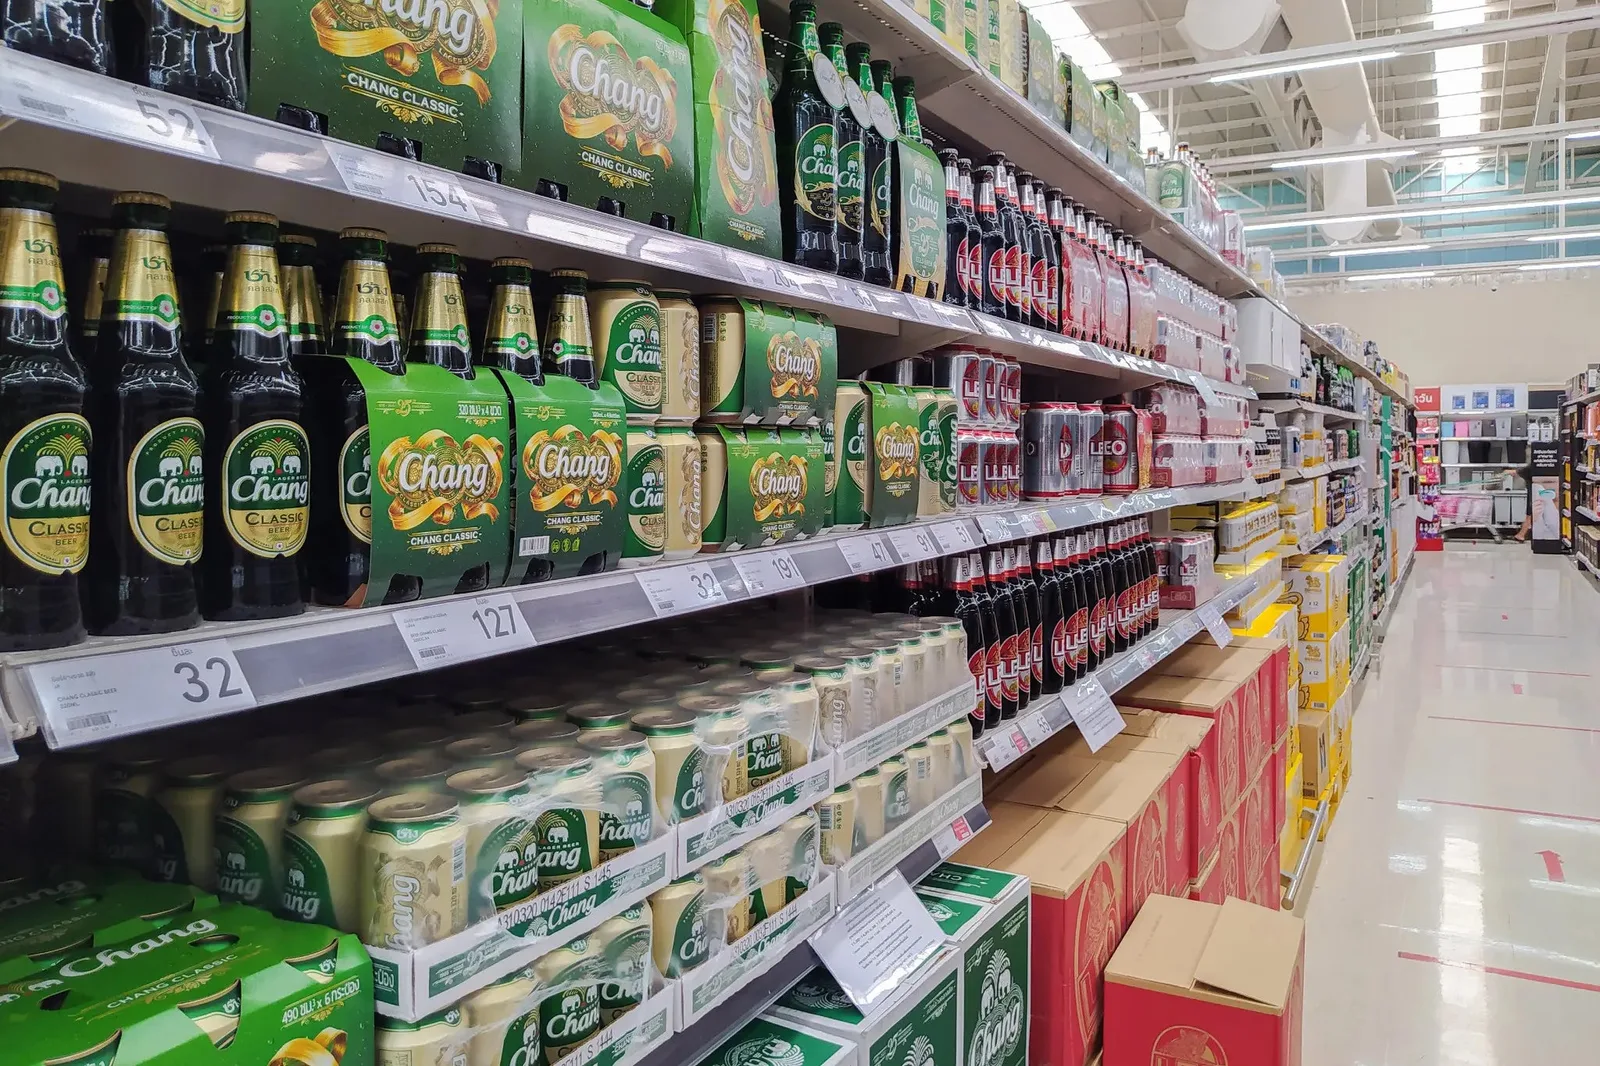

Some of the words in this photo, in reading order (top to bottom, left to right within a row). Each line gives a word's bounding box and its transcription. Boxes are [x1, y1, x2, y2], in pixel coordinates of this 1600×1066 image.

[347, 73, 400, 99] CHANG
[402, 91, 459, 117] CLASSIC
[570, 47, 663, 127] Chang
[727, 14, 753, 185] Chang
[136, 97, 206, 146] 52
[582, 151, 617, 174] CHANG
[617, 161, 651, 182] CLASSIC
[406, 173, 468, 213] 154
[909, 185, 940, 219] Chang
[774, 345, 815, 380] Chang
[20, 426, 56, 453] PRODUCT
[882, 435, 915, 461] Chang
[399, 451, 489, 496] Chang
[538, 444, 611, 484] Chang
[231, 475, 309, 504] Chang
[758, 468, 801, 497] Chang
[245, 512, 304, 526] CLASSIC
[268, 526, 290, 534] BEER
[572, 515, 601, 524] CLASSIC
[178, 532, 196, 540] BEER
[410, 535, 442, 546] CHANG
[444, 530, 479, 542] CLASSIC
[916, 534, 933, 552] 91
[955, 526, 972, 543] 51
[870, 542, 888, 562] 47
[772, 557, 800, 580] 191
[690, 572, 722, 599] 32
[472, 604, 518, 639] 127
[173, 656, 244, 704] 32
[1037, 718, 1050, 733] 55
[548, 893, 598, 929] Chang
[58, 919, 219, 978] Chang
[107, 981, 170, 1009] CHANG
[171, 954, 239, 983] CLASSIC
[281, 1007, 299, 1025] 490
